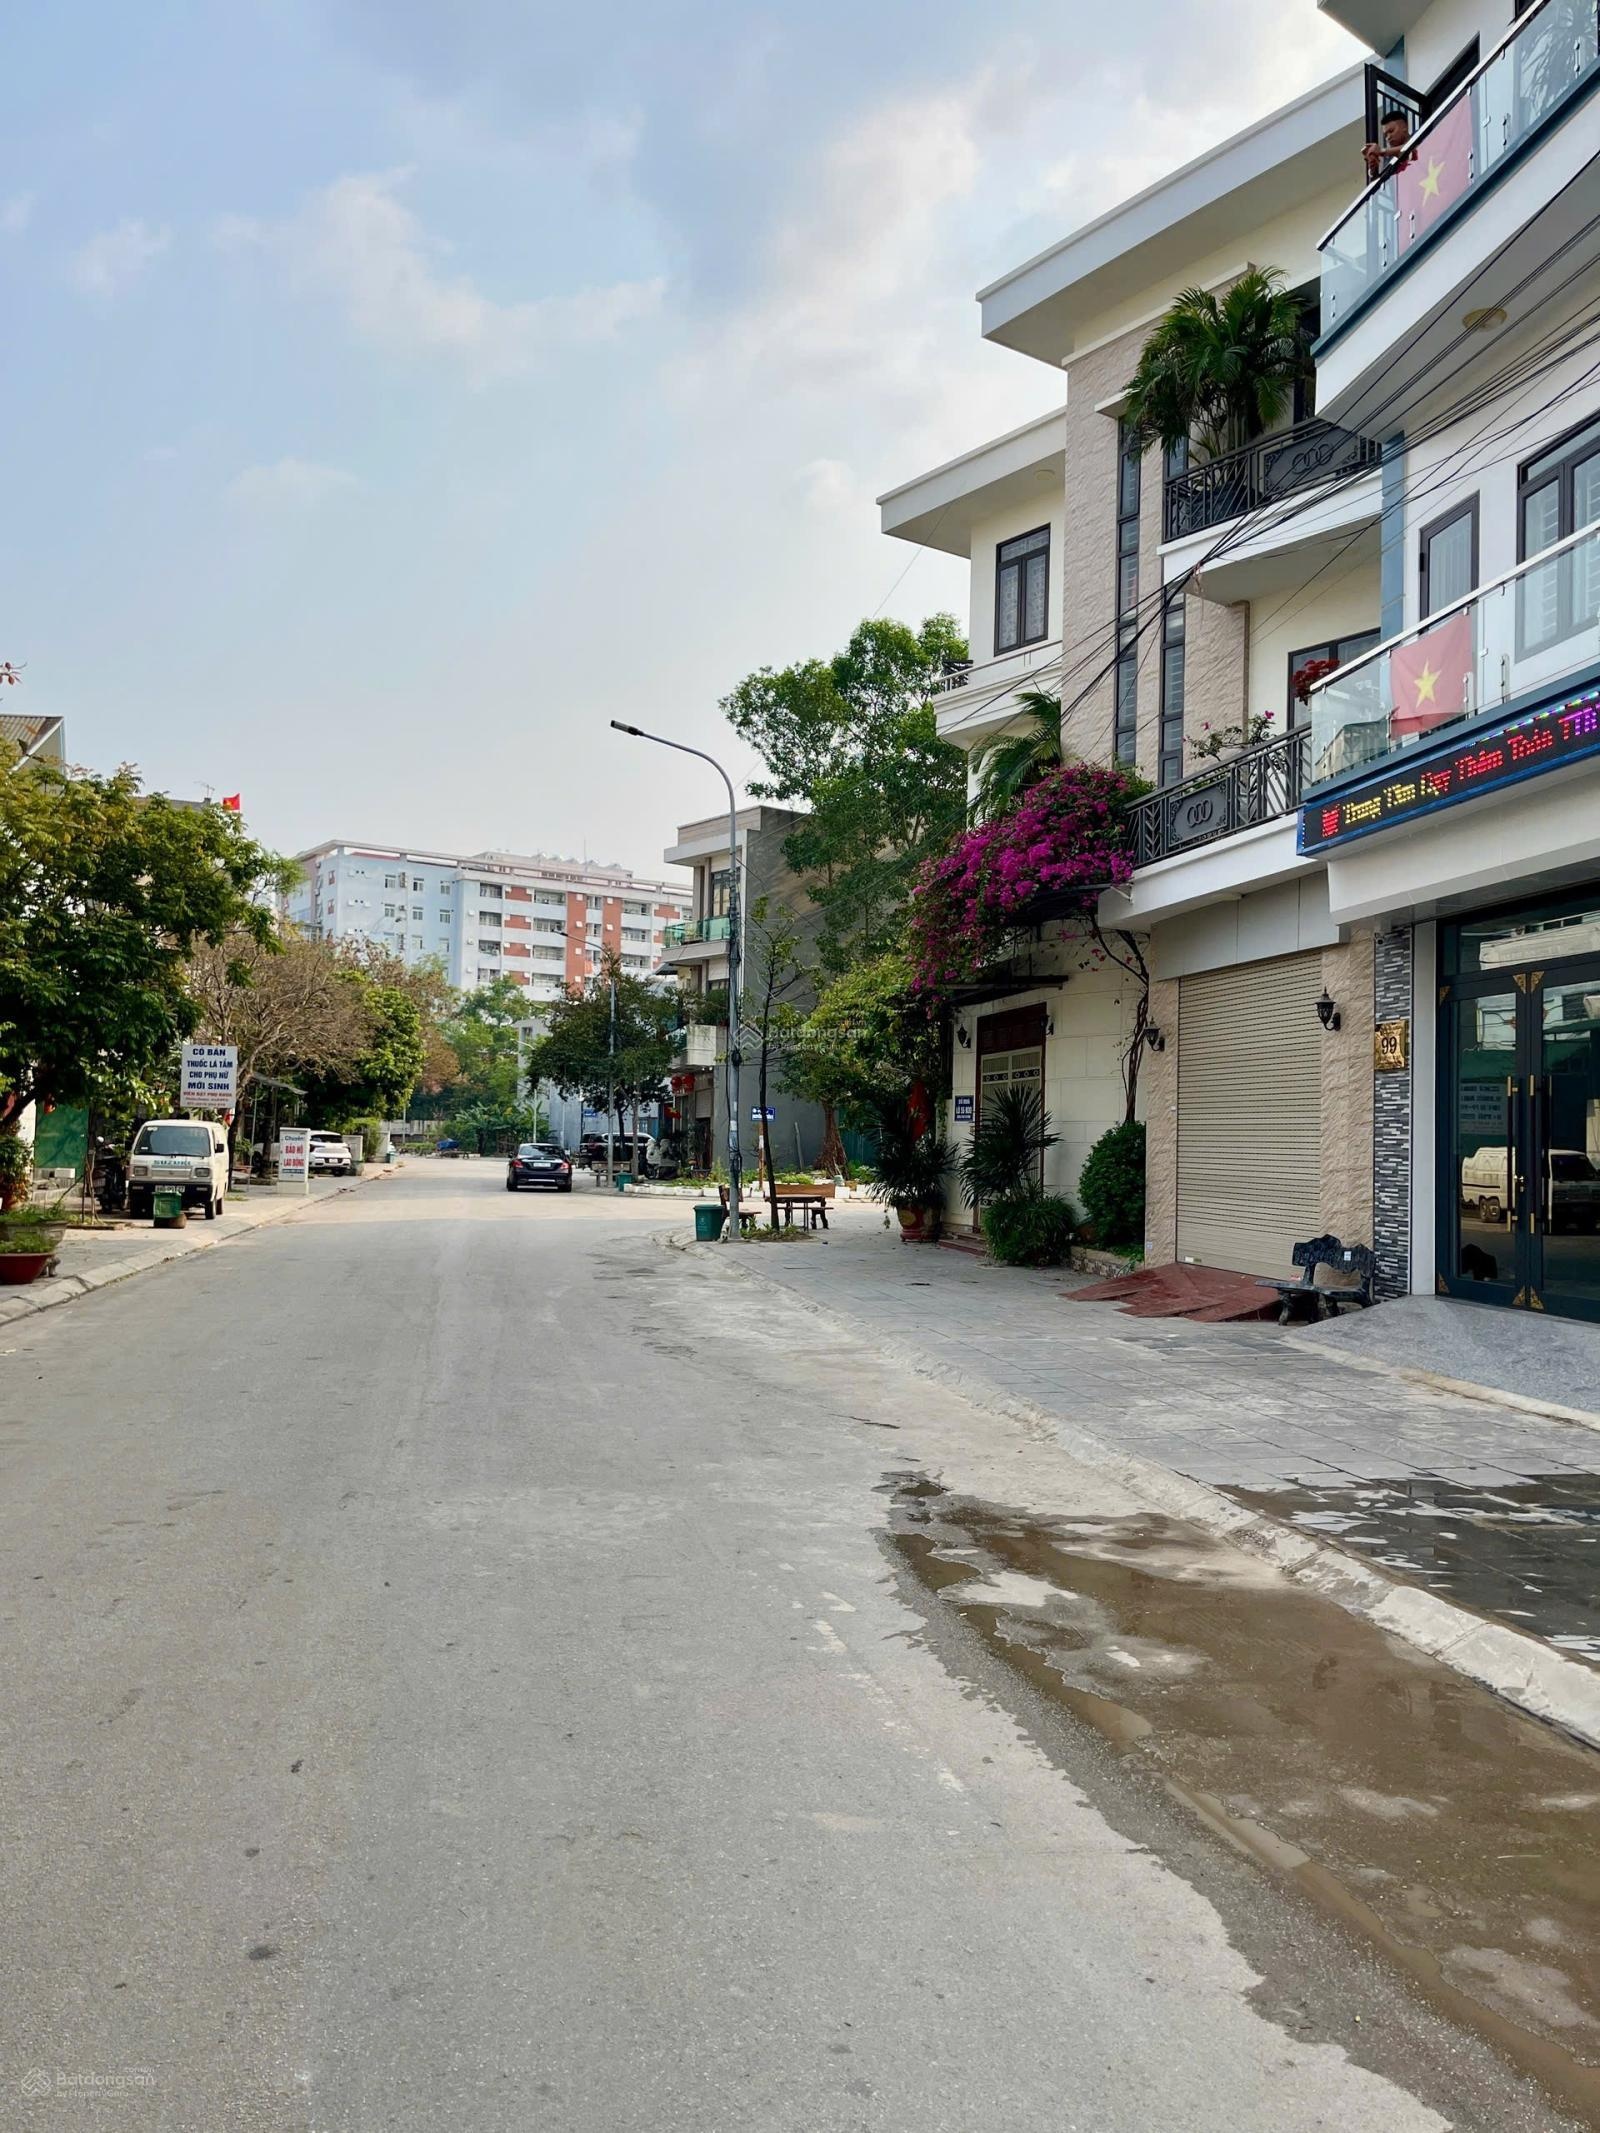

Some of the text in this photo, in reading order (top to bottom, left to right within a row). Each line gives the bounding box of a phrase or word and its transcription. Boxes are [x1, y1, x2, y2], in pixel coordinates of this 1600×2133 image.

[1381, 1036, 1397, 1055] 99
[193, 1047, 226, 1056] CÓ BÁN
[187, 1058, 208, 1068] THUỐC
[209, 1059, 217, 1068] LÁ
[189, 1070, 229, 1080] CHO PHỤ NỮ
[187, 1081, 229, 1090] MỚI SINH
